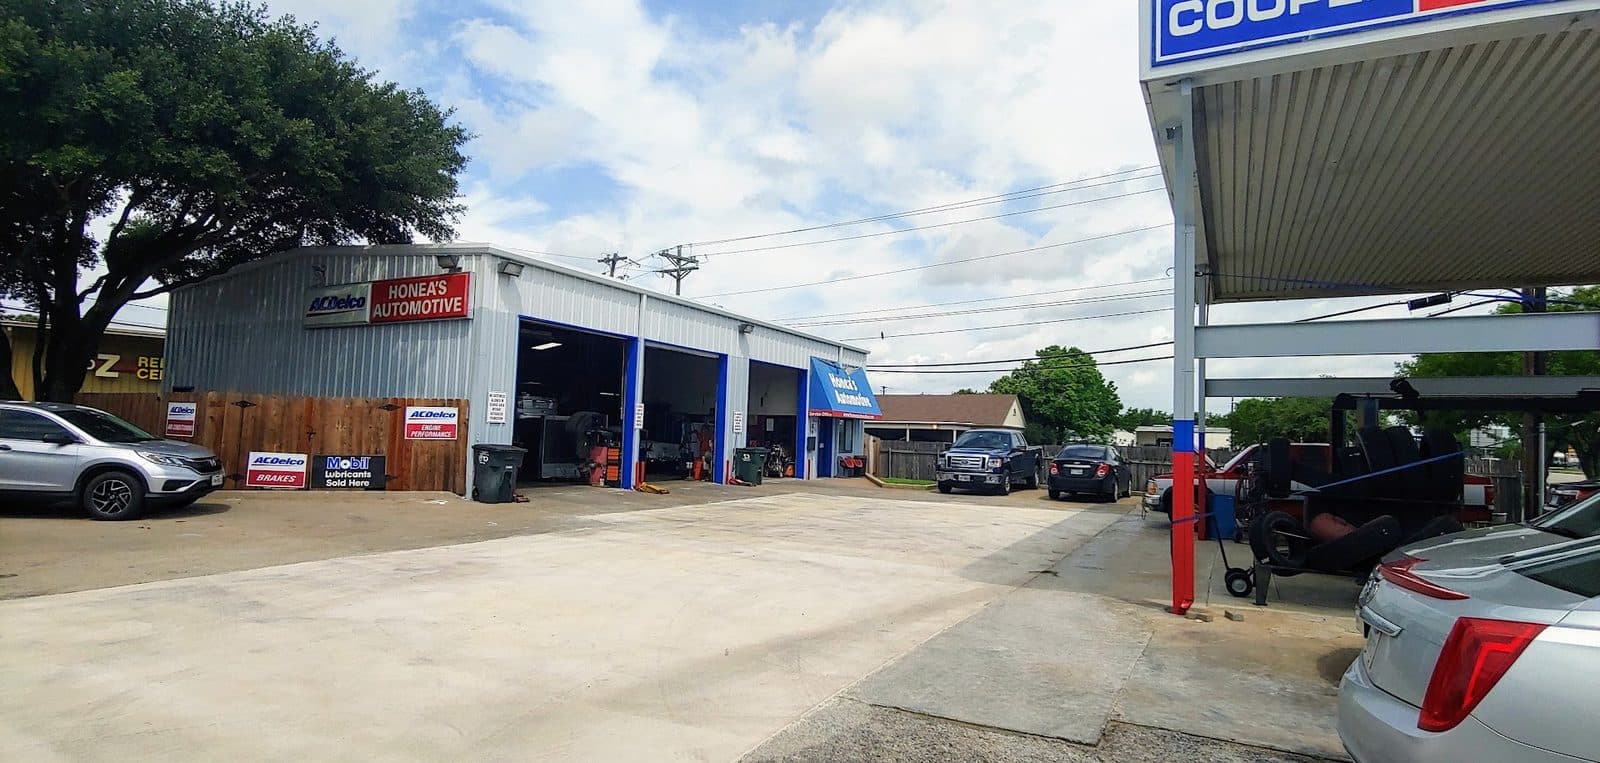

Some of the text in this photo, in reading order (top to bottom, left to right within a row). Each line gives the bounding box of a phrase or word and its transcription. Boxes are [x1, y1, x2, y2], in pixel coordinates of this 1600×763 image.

[389, 280, 447, 300] HONEA'S
[308, 294, 366, 312] ACDelco
[373, 297, 462, 318] AUTOMOTIVE
[95, 353, 120, 378] Z
[410, 410, 456, 418] ACDelco
[410, 430, 452, 438] PERFORMANCE
[254, 456, 305, 466] ACDelco
[326, 456, 371, 470] Mobil
[256, 473, 297, 483] BRAKES
[325, 470, 372, 479] Lubricants
[326, 479, 370, 487] Sold Here
